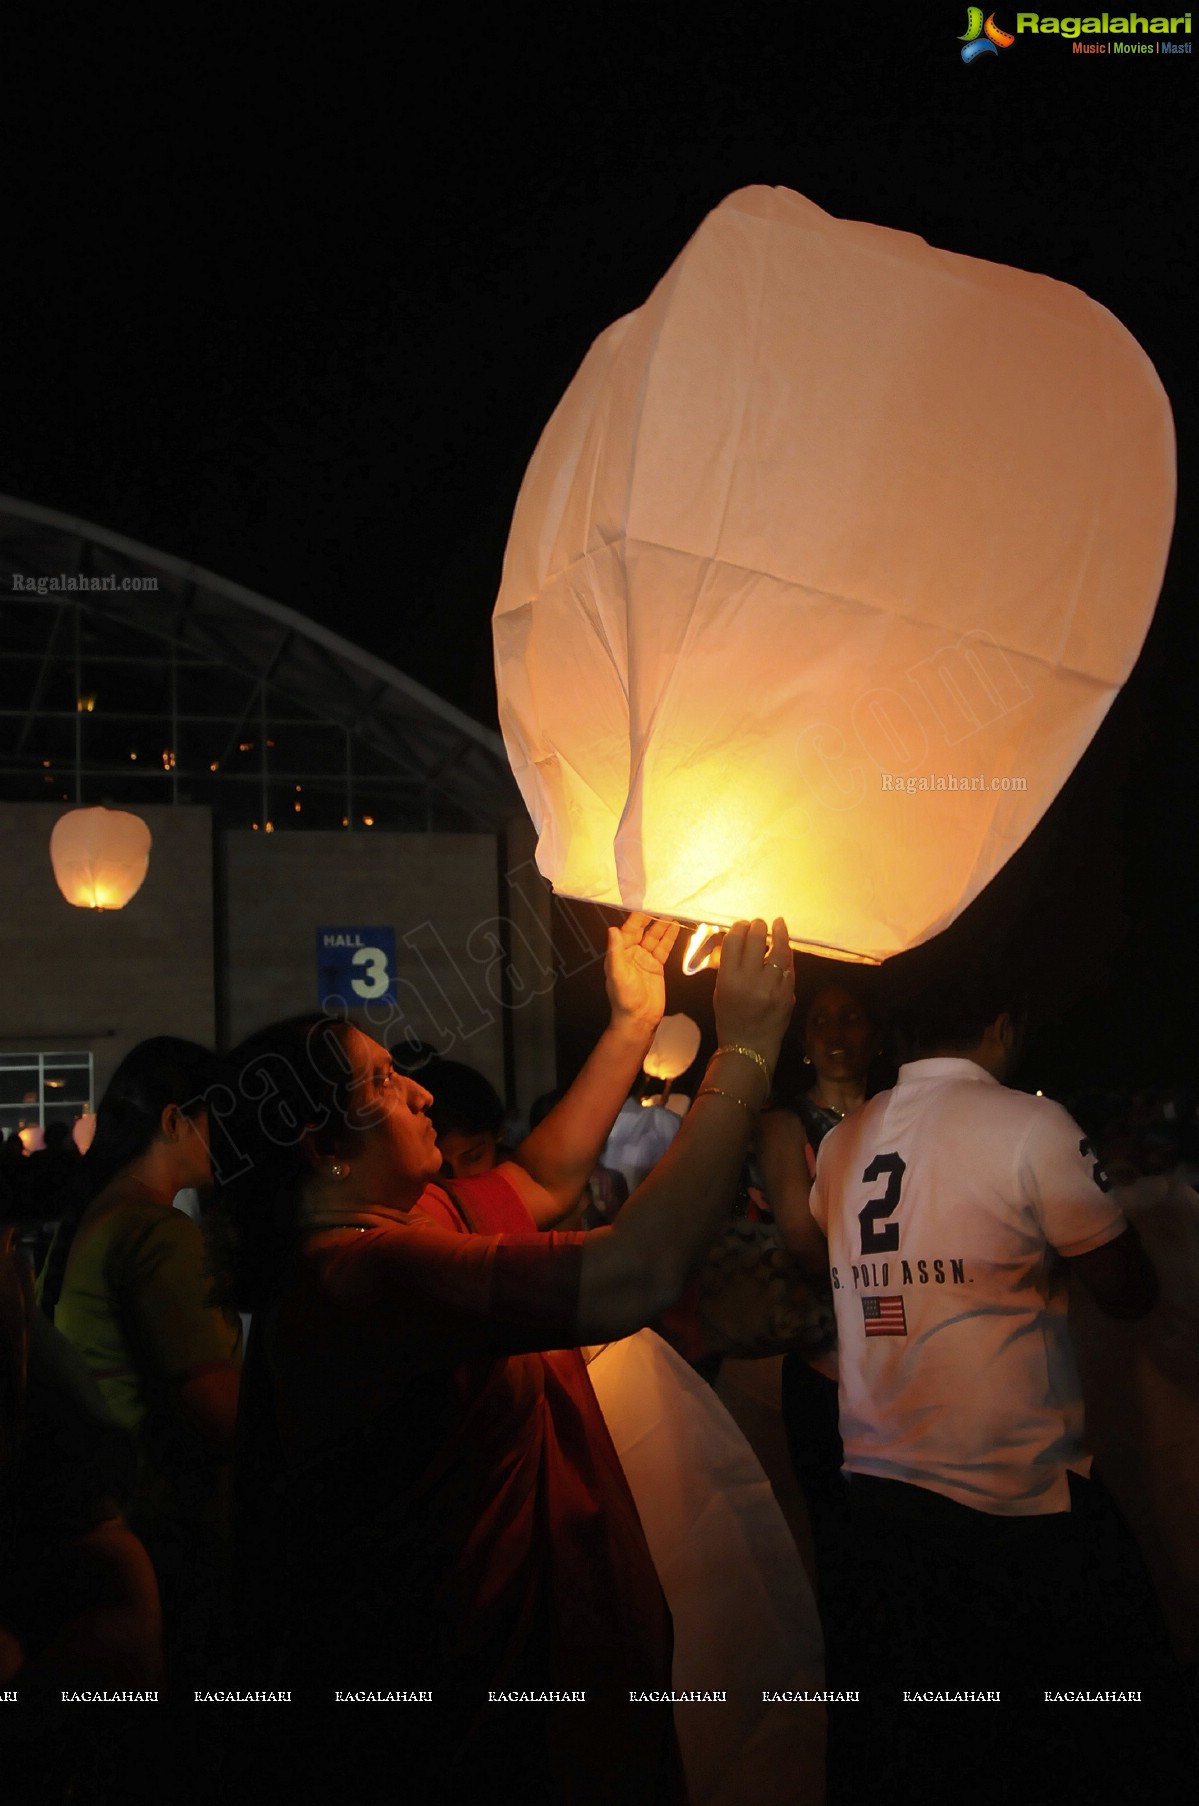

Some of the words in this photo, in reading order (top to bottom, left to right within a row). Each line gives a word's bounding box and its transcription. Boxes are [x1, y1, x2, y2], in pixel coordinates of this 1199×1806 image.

[323, 934, 365, 948] HALL
[351, 946, 390, 1000] 3
[858, 1151, 907, 1256] 2
[851, 1262, 889, 1289] POLO
[901, 1258, 974, 1286] ASSN.
